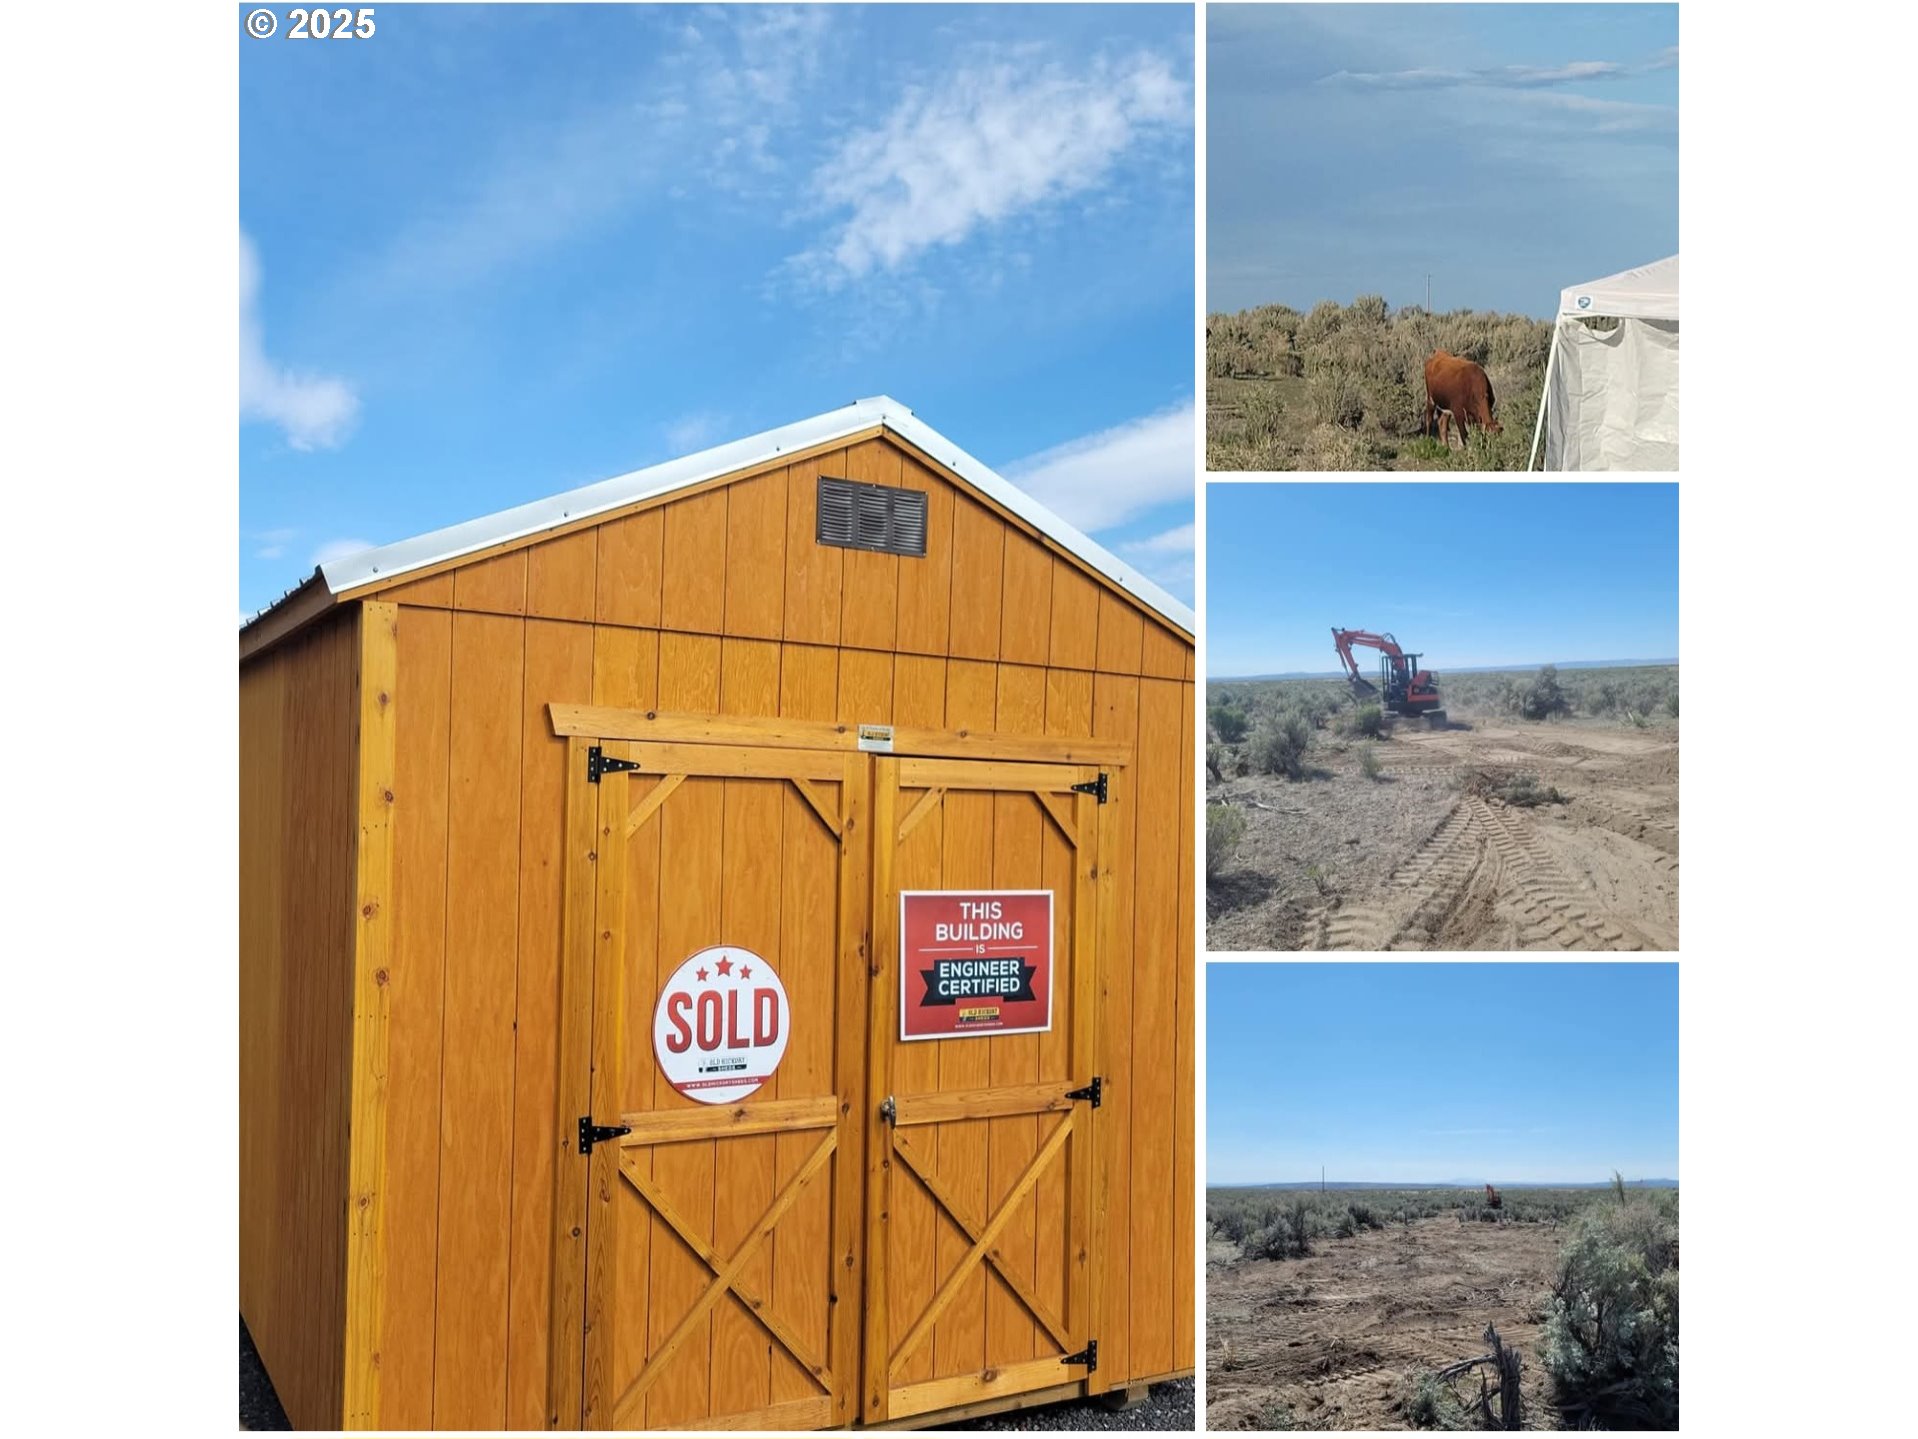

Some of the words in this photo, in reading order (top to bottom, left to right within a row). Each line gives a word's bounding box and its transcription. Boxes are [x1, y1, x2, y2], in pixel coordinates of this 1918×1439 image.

[959, 901, 1003, 920] THIS
[935, 921, 1024, 942] BUILDING
[975, 943, 986, 954] IS
[939, 960, 1020, 978] ENGINEER
[938, 978, 1020, 996] CERTIFIED
[666, 987, 780, 1054] SOLD
